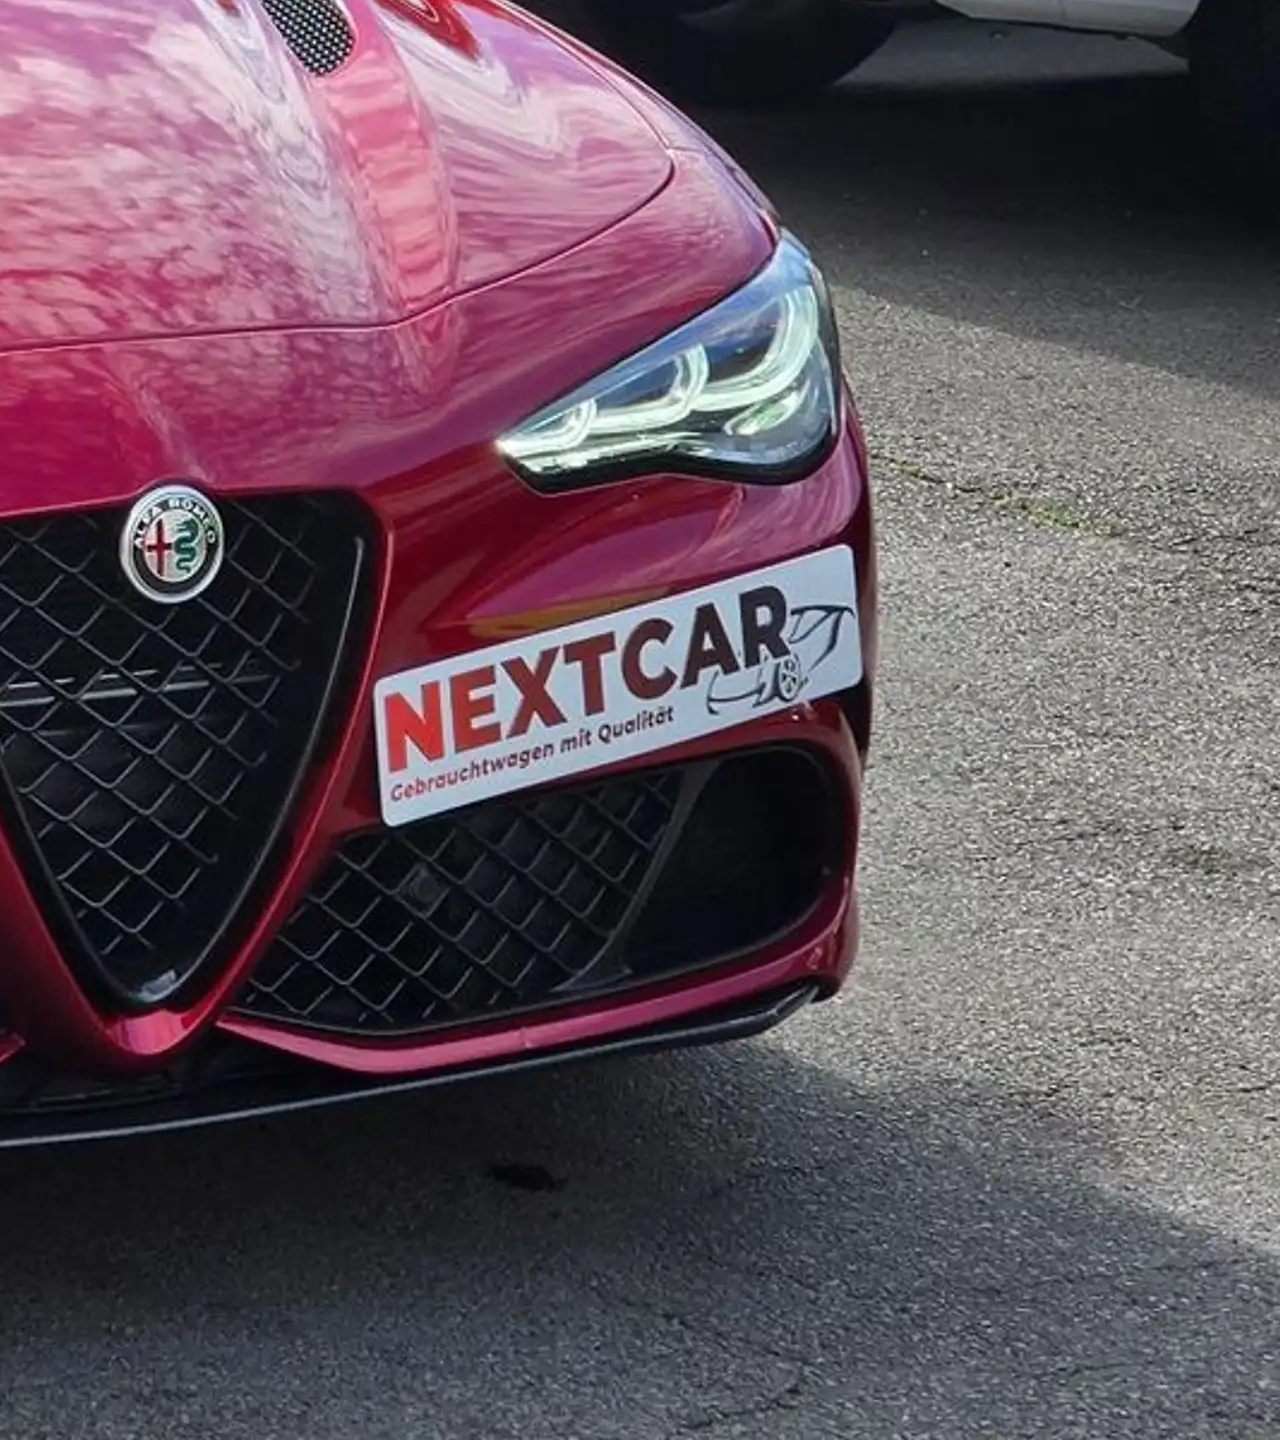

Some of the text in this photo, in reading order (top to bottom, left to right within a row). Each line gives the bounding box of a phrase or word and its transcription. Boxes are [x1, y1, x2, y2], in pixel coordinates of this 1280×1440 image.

[383, 585, 791, 773] NEXTCAR
[390, 705, 675, 802] Gebrauchtwagen mit Qualität
